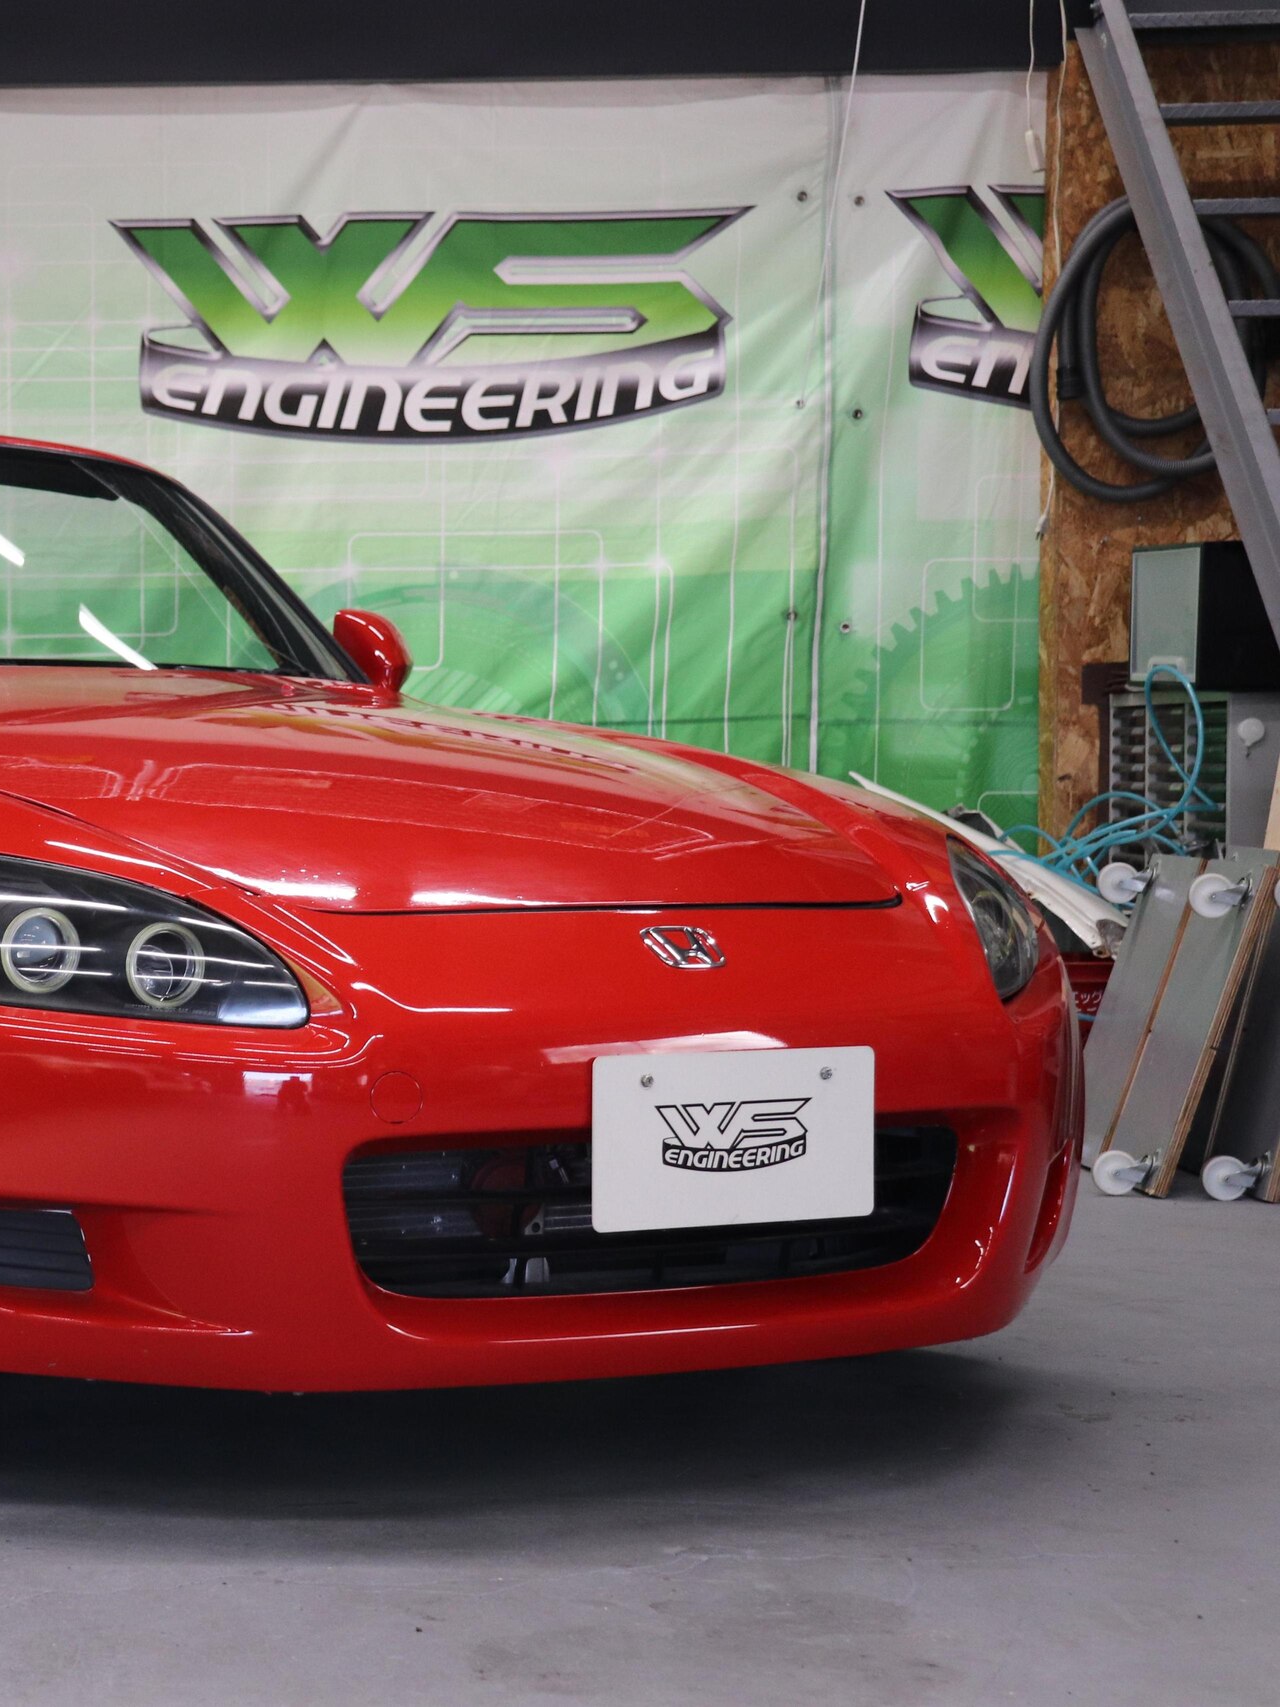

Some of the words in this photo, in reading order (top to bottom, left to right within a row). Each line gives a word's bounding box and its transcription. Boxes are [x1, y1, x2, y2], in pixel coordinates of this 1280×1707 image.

[108, 204, 756, 367] WS
[150, 348, 716, 433] ENGINEERING
[655, 1097, 812, 1149] WS
[664, 1139, 805, 1169] ENGINEERING
